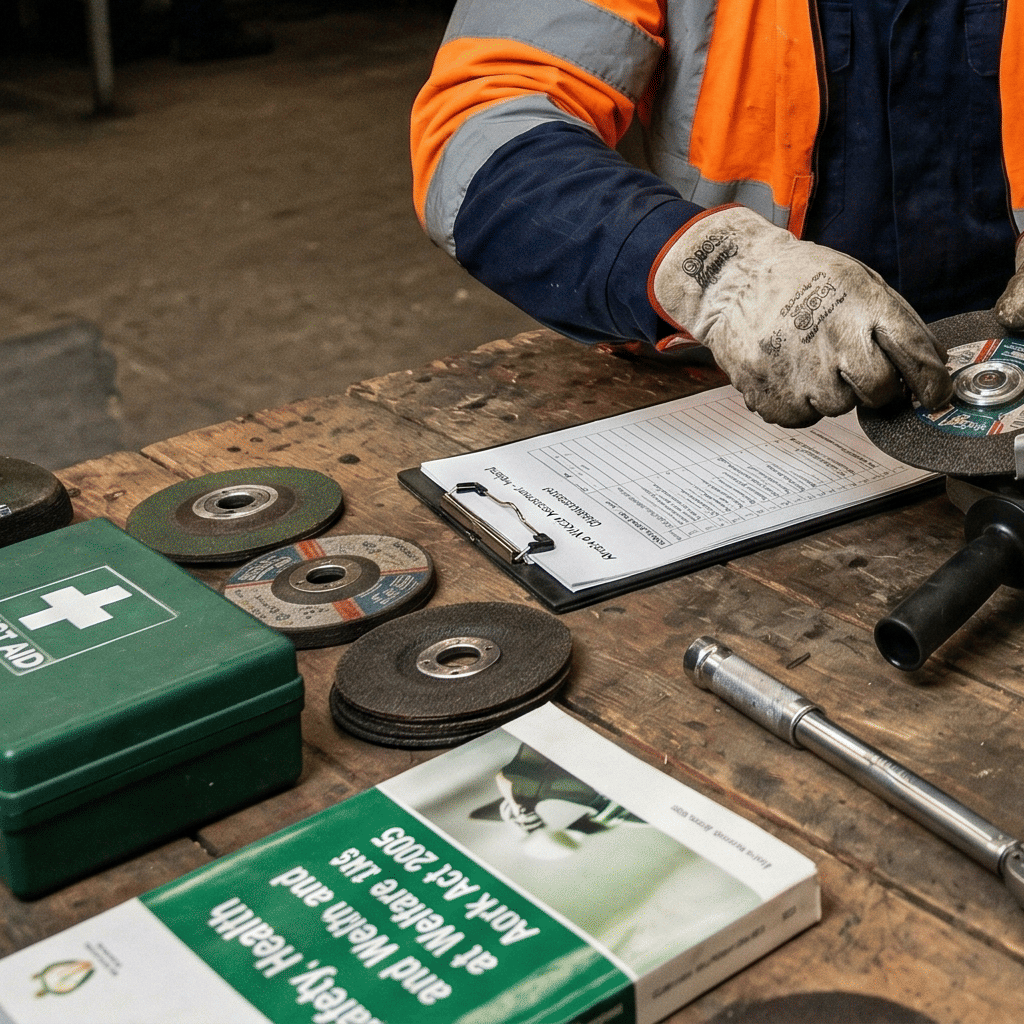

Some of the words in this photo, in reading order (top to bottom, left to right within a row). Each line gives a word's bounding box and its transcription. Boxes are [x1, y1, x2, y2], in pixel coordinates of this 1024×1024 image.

[0, 642, 45, 669] AID
[370, 826, 440, 873] 2005
[268, 865, 335, 908] and
[422, 863, 481, 901] Act
[207, 896, 304, 978] Health
[369, 878, 466, 958] Welfare
[378, 955, 452, 1006] and
[449, 943, 499, 976] at
[288, 958, 386, 1024] afety,
